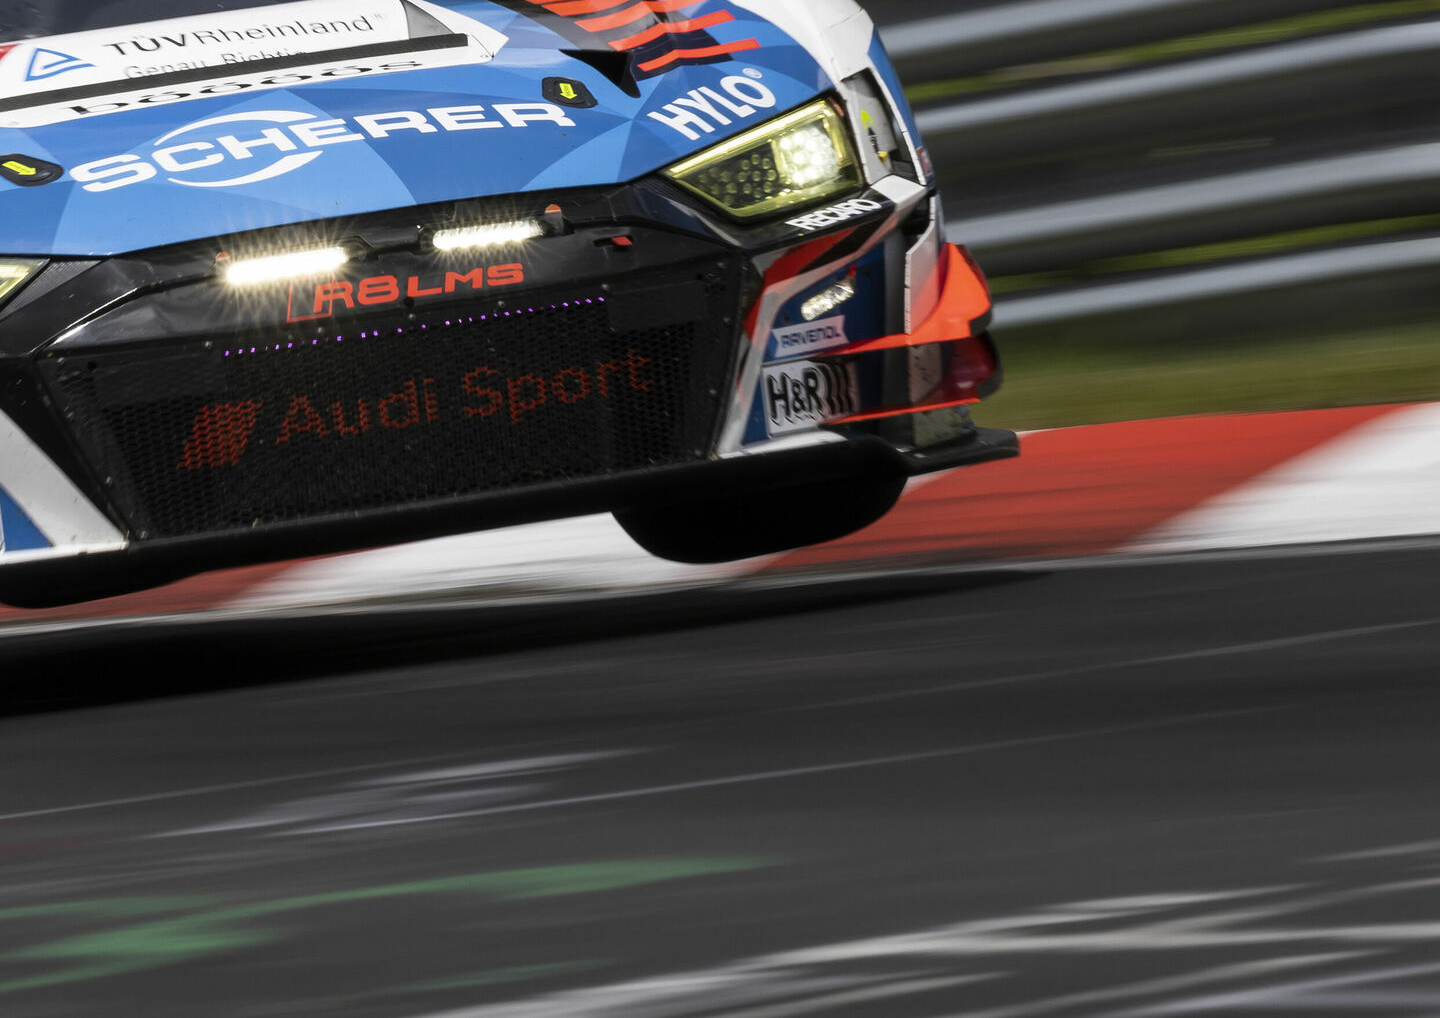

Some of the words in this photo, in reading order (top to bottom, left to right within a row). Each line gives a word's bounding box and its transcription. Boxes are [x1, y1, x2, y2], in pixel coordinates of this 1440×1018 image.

[647, 75, 777, 140] HYLO
[69, 102, 576, 193] SCHERER
[784, 198, 883, 231] RECARO
[313, 274, 400, 314] R8
[407, 262, 526, 298] LMS
[275, 376, 440, 446] Audi
[463, 349, 652, 425] Sport
